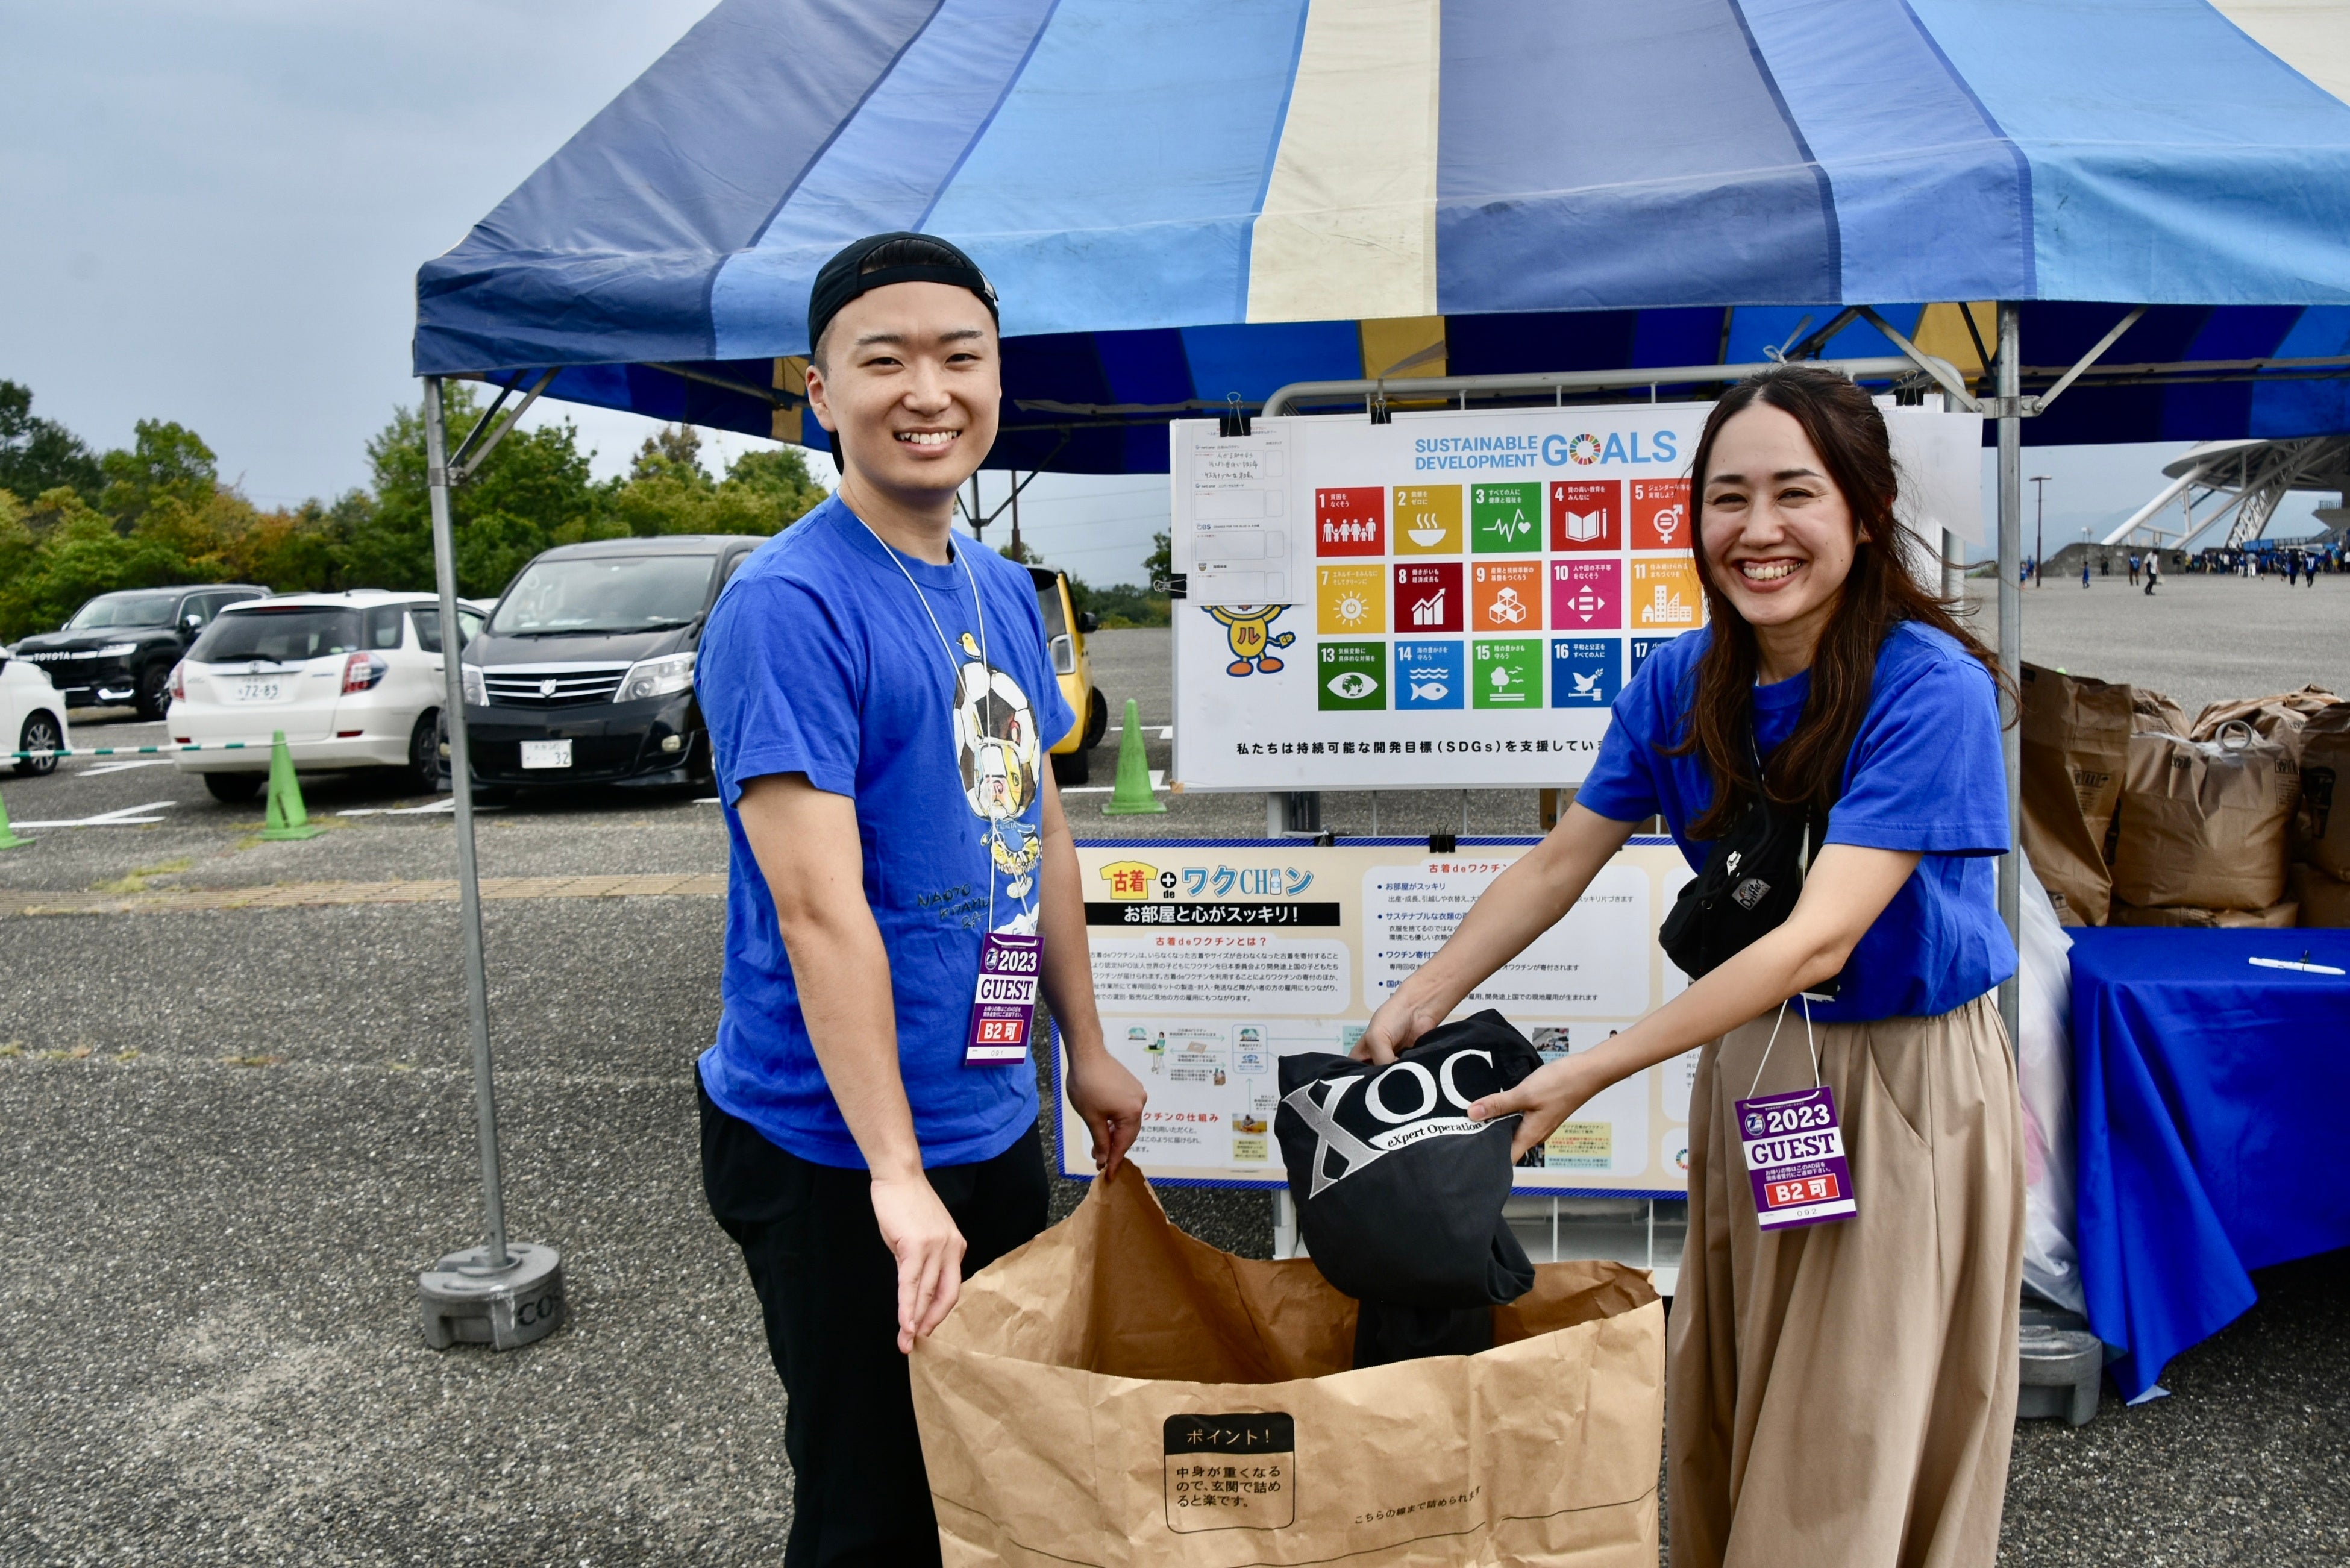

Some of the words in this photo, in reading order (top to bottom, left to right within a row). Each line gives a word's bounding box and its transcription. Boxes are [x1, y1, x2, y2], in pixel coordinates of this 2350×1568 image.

[1415, 435, 1538, 453] SUSTAINABLE
[1541, 430, 1677, 466] GOALS
[1415, 453, 1538, 470] DEVELOPMENT
[1398, 491, 1406, 506] 2
[1476, 489, 1485, 504] 3
[1555, 487, 1564, 501] 4
[1635, 485, 1644, 500] 5
[1319, 494, 1325, 508] 1
[1321, 571, 1329, 585] 7
[1398, 569, 1407, 583] 8
[1476, 567, 1485, 582] 9
[1491, 574, 1526, 582] 基盤をつくろう
[1554, 565, 1568, 580] 10
[1634, 564, 1646, 579] 11
[1237, 627, 1261, 645] ル
[34, 651, 70, 662] TOYOTA
[1321, 648, 1335, 662] 13
[1398, 647, 1412, 661] 14
[1476, 645, 1490, 660] 15
[1555, 644, 1569, 659] 16
[1634, 642, 1647, 657] 17
[1113, 870, 1145, 893] 古着
[1163, 890, 1175, 898] de
[1385, 882, 1446, 891] お部屋がスッキリ
[1740, 879, 1761, 909] Drifter
[998, 950, 1038, 973] 2023
[981, 979, 1033, 1000] GUEST
[983, 1023, 1003, 1040] B2
[1005, 1023, 1018, 1041] 可
[1767, 1104, 1831, 1133] 2023
[1388, 1127, 1426, 1147] eXpert
[1427, 1121, 1482, 1134] Operation
[1752, 1133, 1835, 1164] GUEST
[1775, 1183, 1804, 1202] B2
[1808, 1179, 1827, 1197] 可
[1797, 1208, 1817, 1217] 092
[1187, 1428, 1270, 1445] ポイント！
[1176, 1466, 1281, 1479] 中身が重くなる
[1176, 1480, 1281, 1493] ので、玄関で詰め
[1177, 1495, 1249, 1507] ると楽です。
[1355, 1485, 1481, 1524] こちらの線まで詰められます
